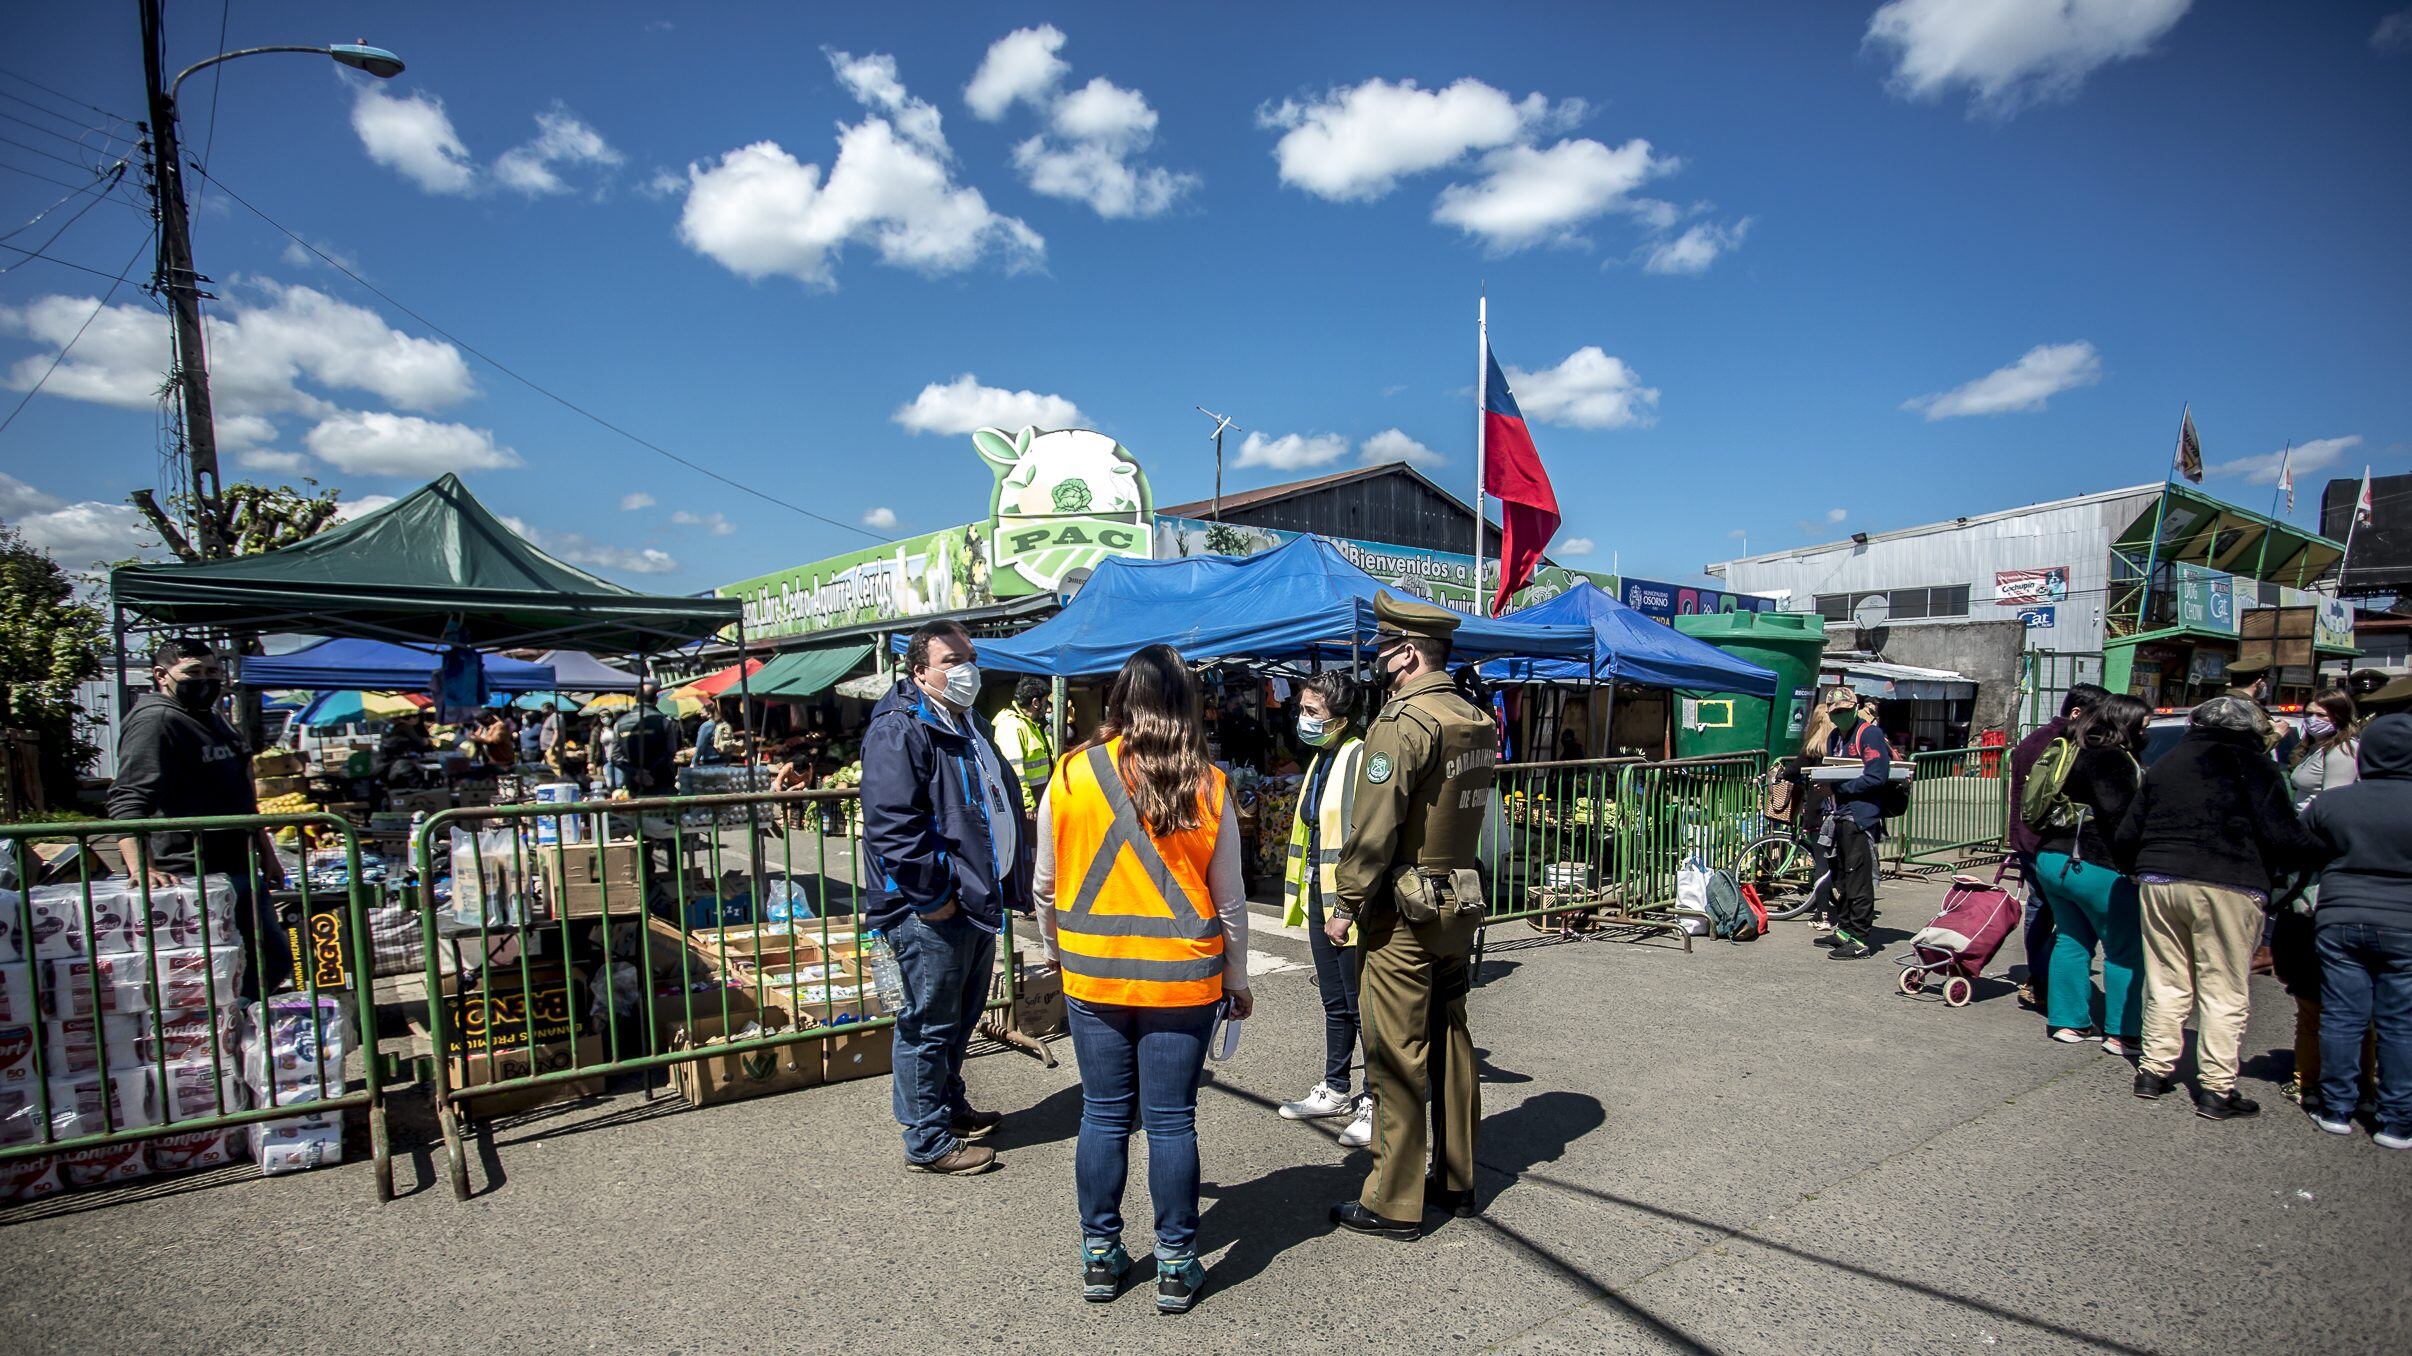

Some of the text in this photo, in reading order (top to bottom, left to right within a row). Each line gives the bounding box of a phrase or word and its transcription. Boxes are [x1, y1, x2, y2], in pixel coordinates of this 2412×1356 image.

[1010, 526, 1134, 554] PAC
[1349, 546, 1449, 578] Bienvenidos
[1456, 565, 1467, 581] a
[781, 575, 810, 622] Pedro
[813, 569, 851, 627] Aguirre
[855, 555, 892, 611] Cerda
[1643, 596, 1669, 607] OSORNO
[1439, 590, 1484, 616] Aguirr
[2210, 593, 2229, 619] Cat
[2018, 612, 2050, 627] Cat
[1025, 992, 1040, 1008] Soft
[150, 1021, 213, 1037] Confor
[519, 1022, 583, 1040] BNANS
